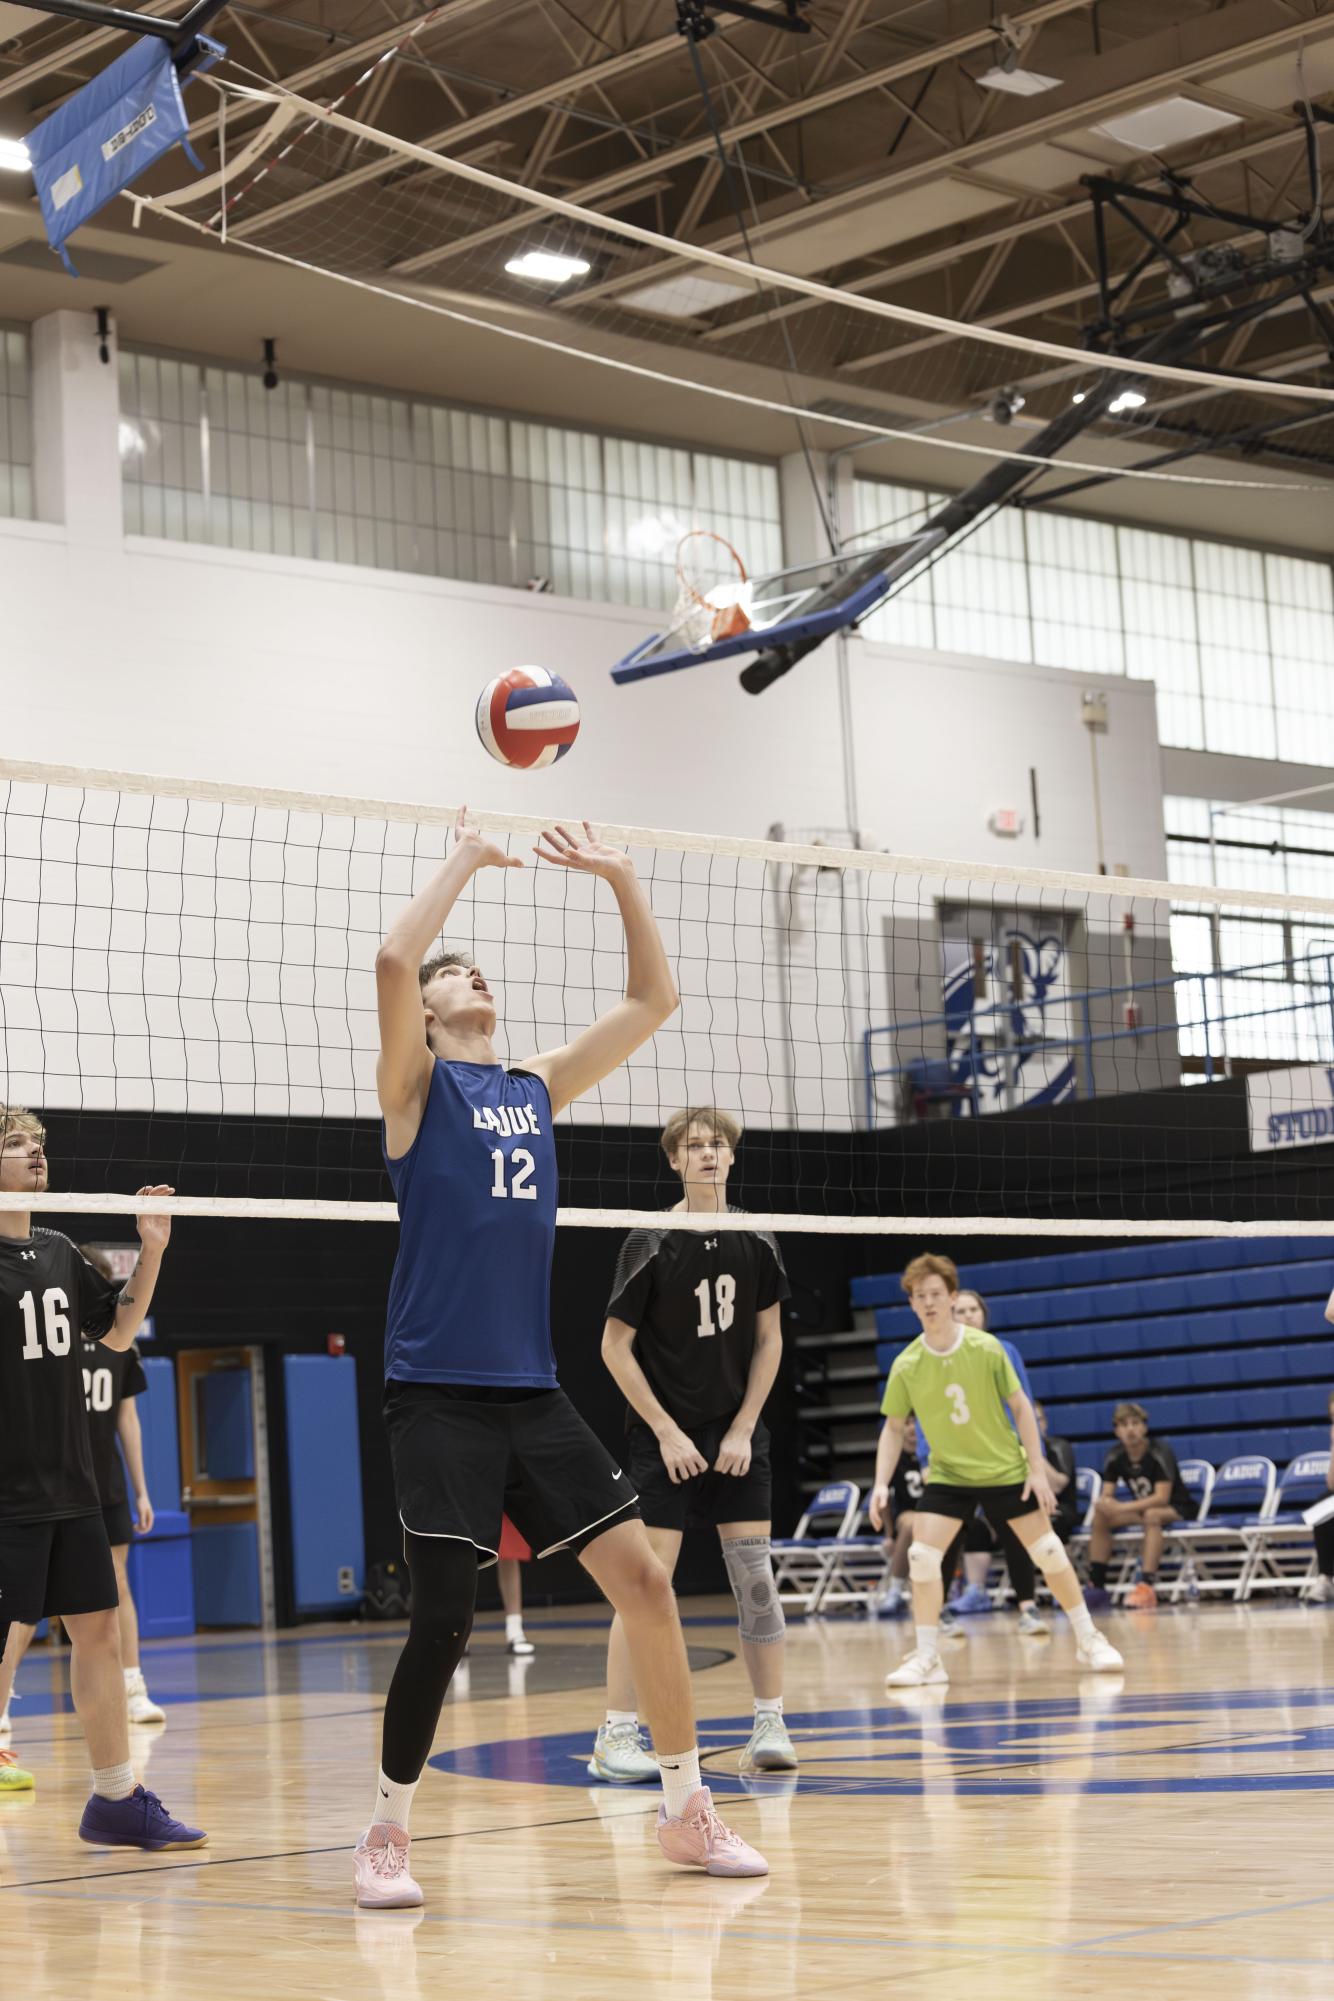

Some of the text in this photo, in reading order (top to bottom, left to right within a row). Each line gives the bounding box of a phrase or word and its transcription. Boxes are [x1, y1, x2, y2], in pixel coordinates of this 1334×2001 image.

[1268, 1106, 1334, 1143] STUD
[491, 1148, 537, 1199] 12
[18, 1287, 71, 1360] 16
[694, 1274, 736, 1337] 18
[945, 1383, 970, 1425] 3
